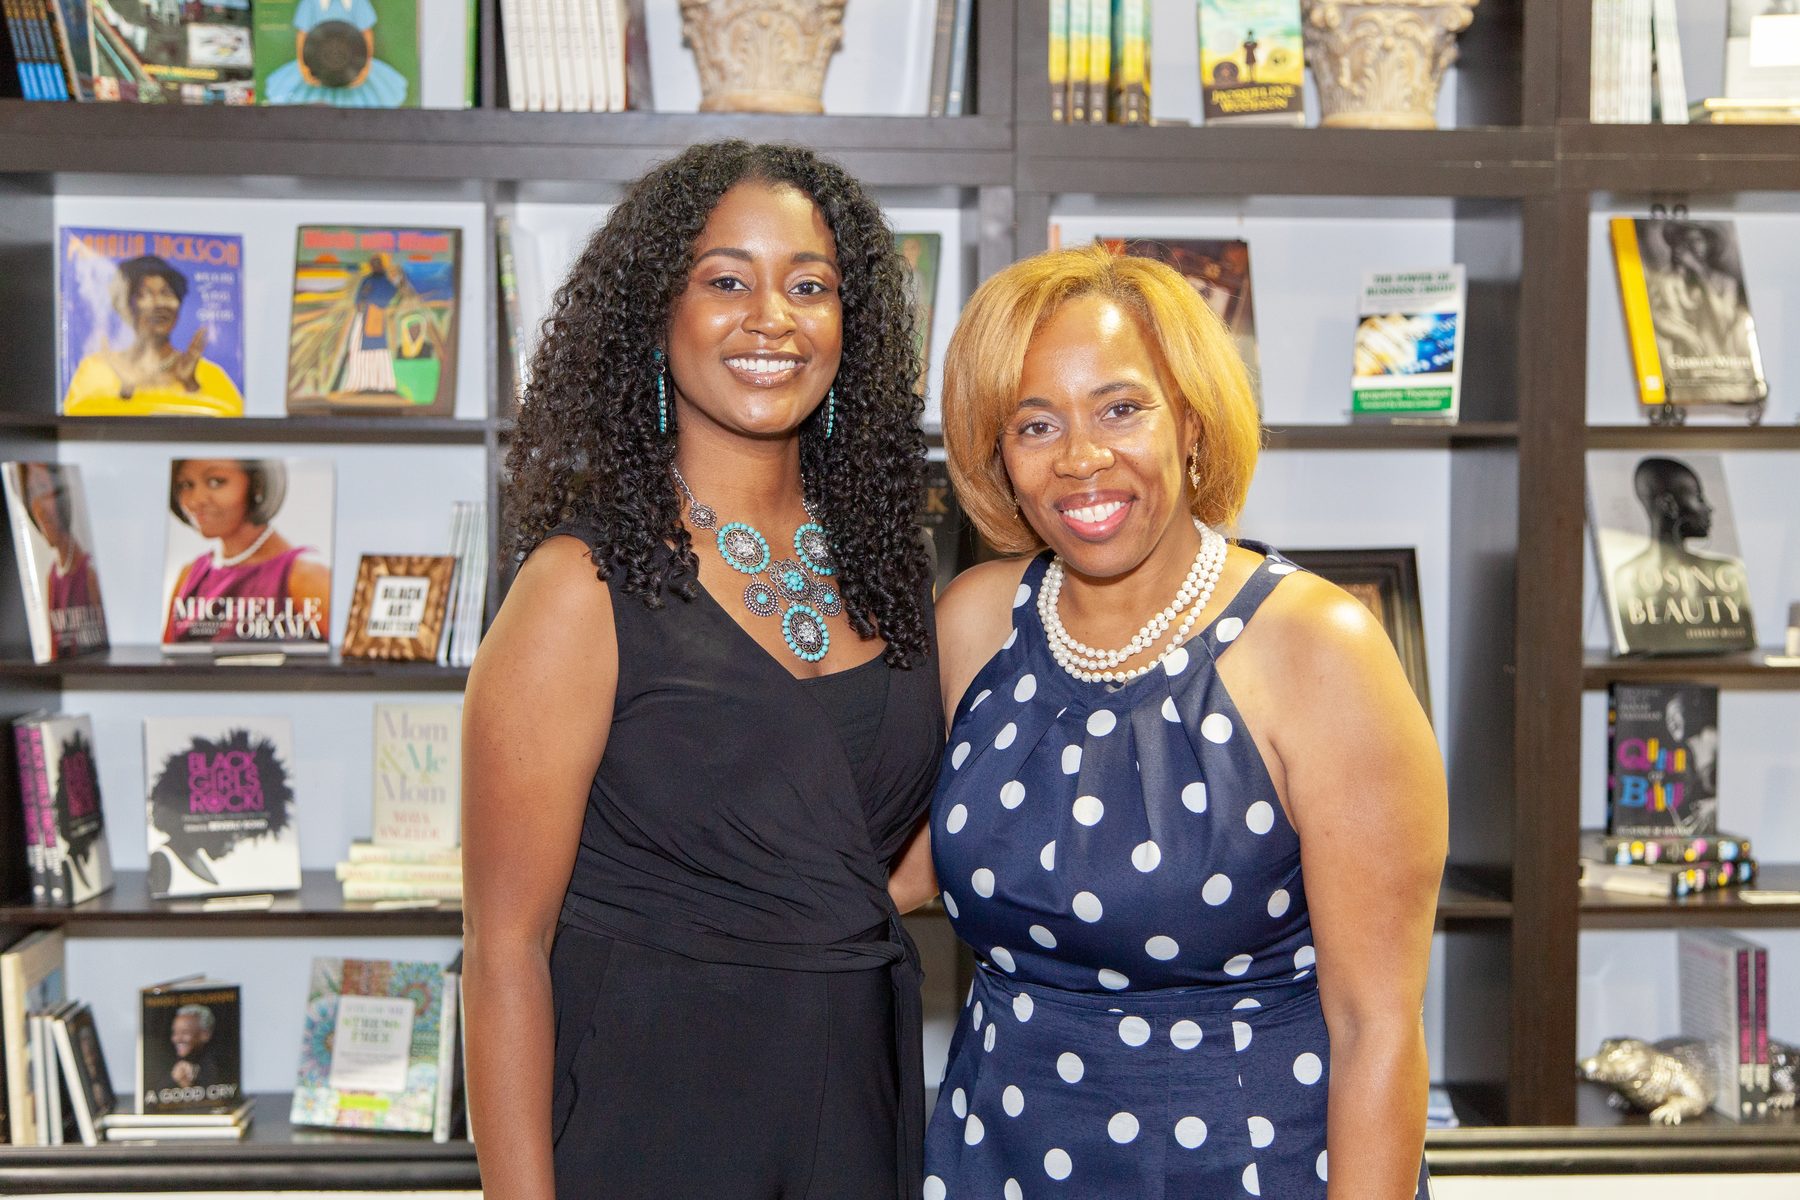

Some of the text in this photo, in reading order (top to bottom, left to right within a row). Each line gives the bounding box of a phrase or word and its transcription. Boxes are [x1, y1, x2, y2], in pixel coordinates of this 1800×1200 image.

[154, 235, 240, 268] JACKSON
[1633, 565, 1738, 593] OSING
[174, 597, 322, 621] MICHELLE
[1628, 596, 1741, 624] BEAUTY
[236, 614, 321, 639] OBAMA
[383, 711, 449, 741] Mom
[188, 751, 257, 776] BLACK
[189, 769, 261, 795] GIRLS
[382, 773, 446, 803] Mom
[190, 790, 265, 815] ROCK!
[144, 1083, 237, 1104] A GOOD CRY
